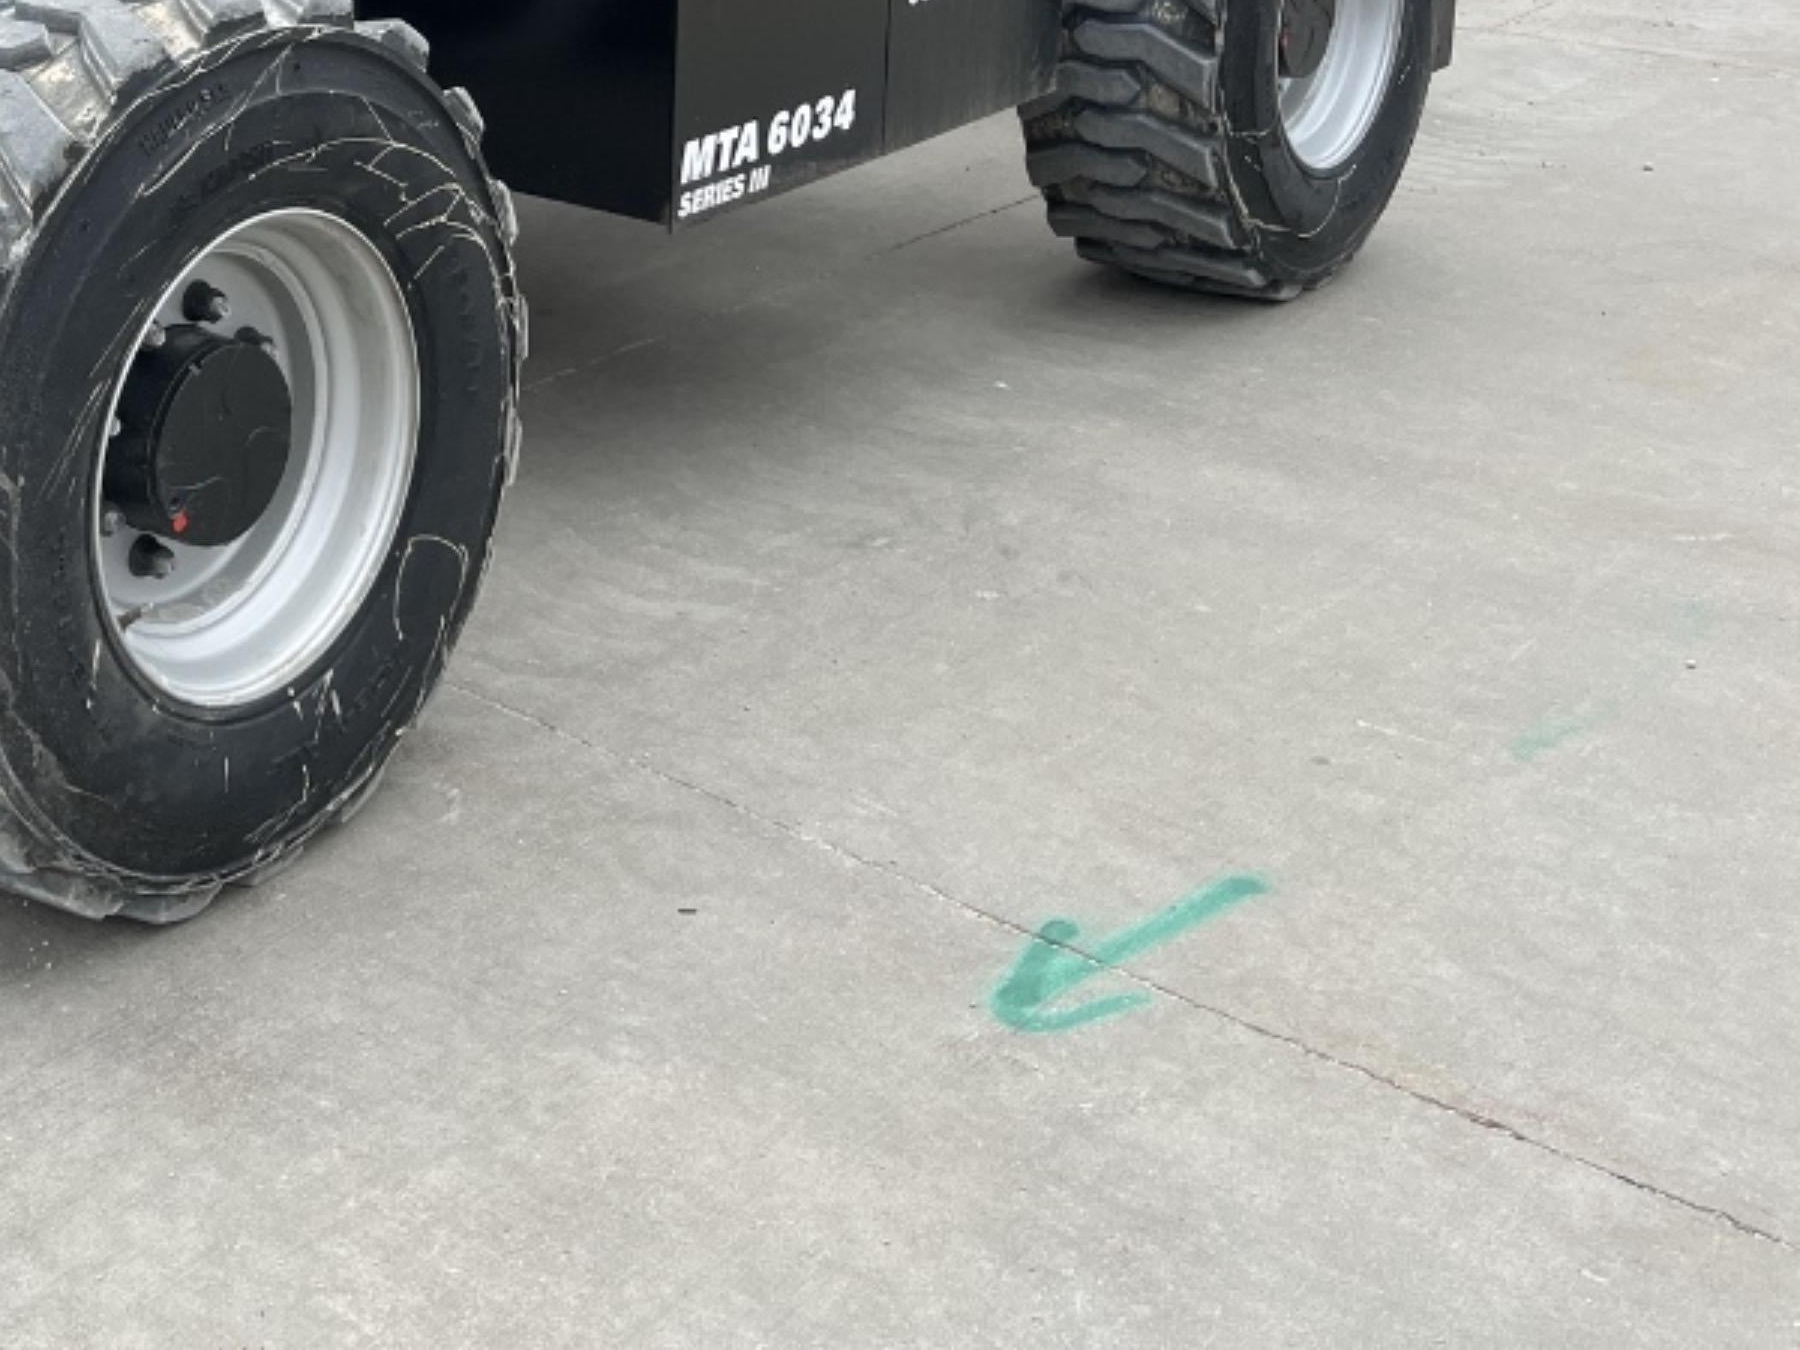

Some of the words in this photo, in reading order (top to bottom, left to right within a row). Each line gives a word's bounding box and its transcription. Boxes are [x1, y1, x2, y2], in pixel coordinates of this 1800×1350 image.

[679, 119, 760, 185] MTA
[767, 89, 857, 155] 6034
[676, 172, 746, 218] SERIES
